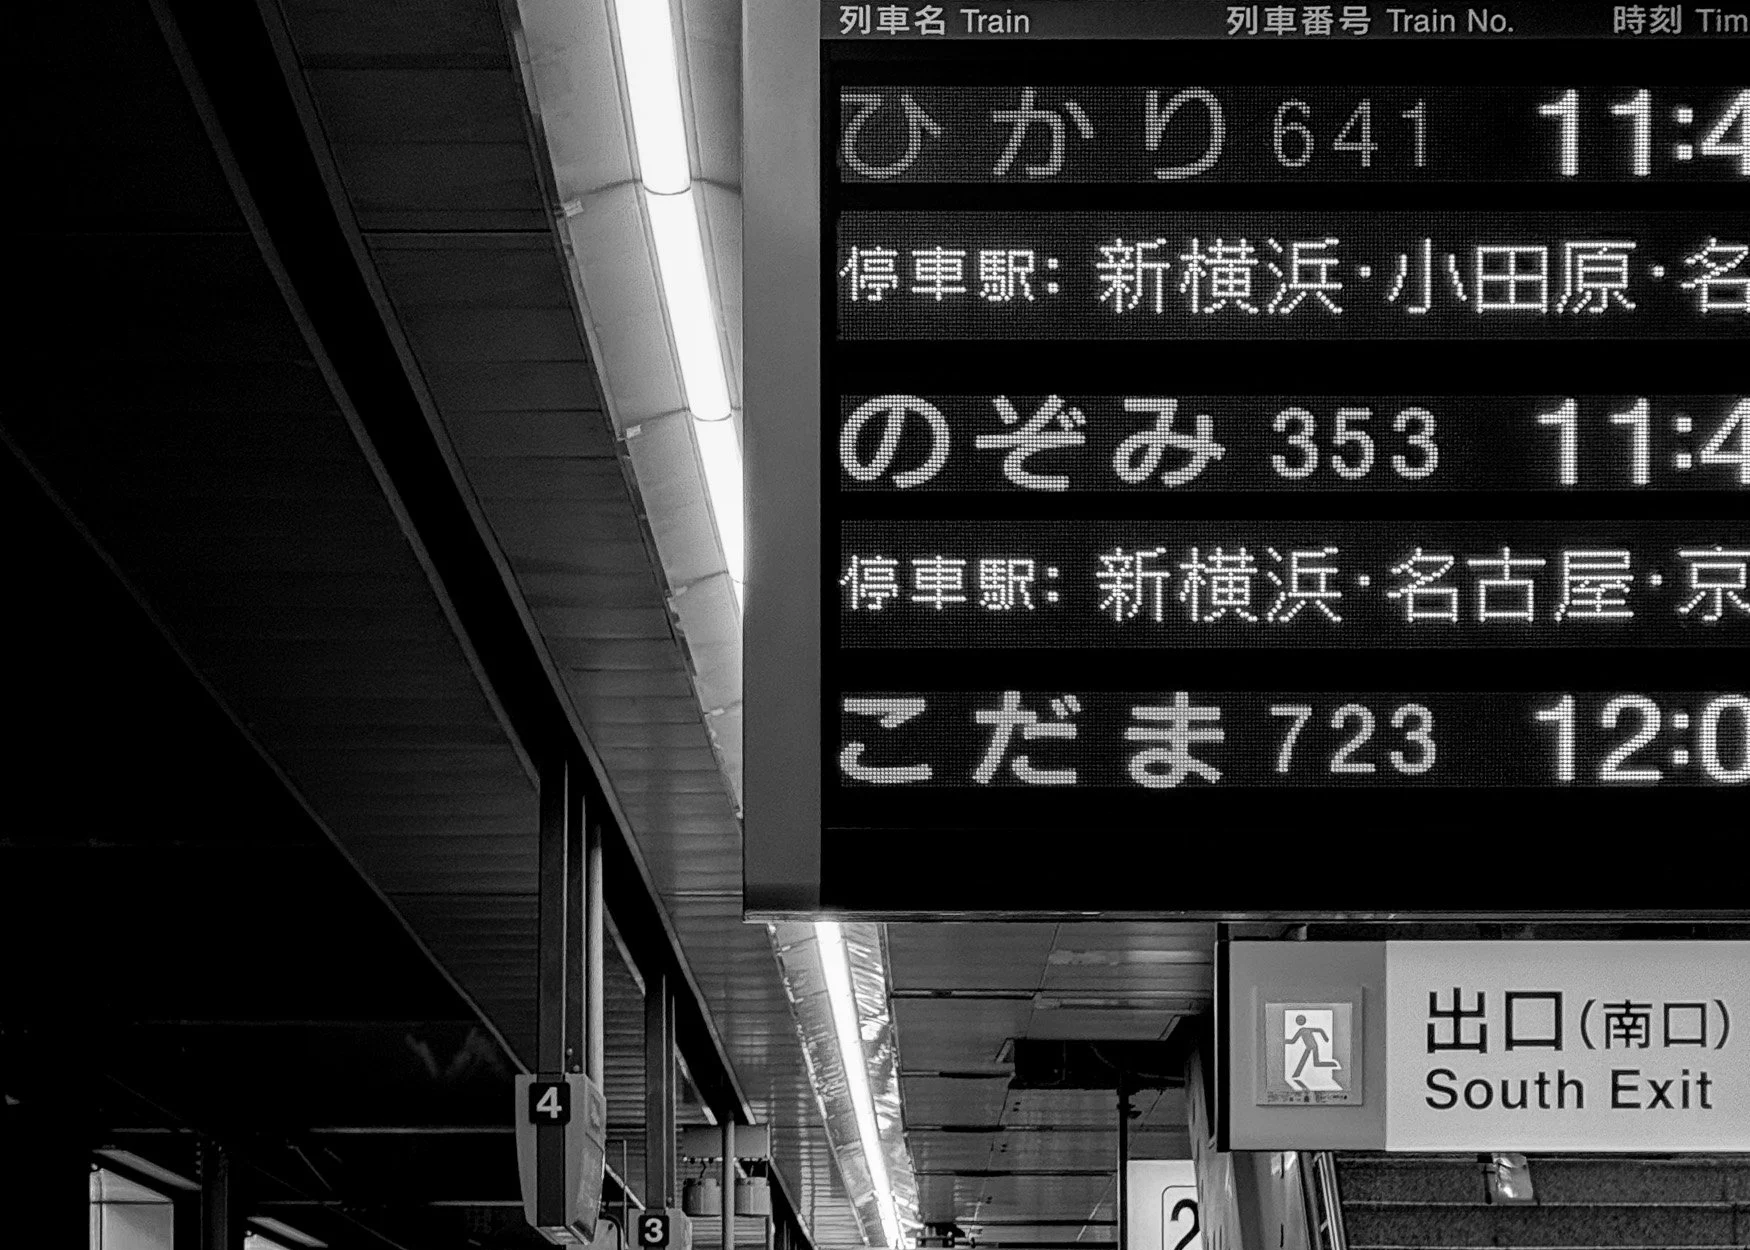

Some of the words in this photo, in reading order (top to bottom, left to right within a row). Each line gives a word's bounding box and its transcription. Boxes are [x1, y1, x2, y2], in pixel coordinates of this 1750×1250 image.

[839, 5, 945, 36] 列車名
[959, 9, 1030, 33] Train
[1226, 5, 1371, 36] 列車番号
[1386, 9, 1455, 33] Train
[1468, 9, 1515, 33] No.
[1613, 5, 1682, 36] 時刻
[1273, 98, 1427, 167] 641
[1272, 406, 1439, 479] 353
[1270, 703, 1437, 776] 723
[536, 1087, 562, 1118] 4
[1425, 1068, 1585, 1110] South
[1611, 1068, 1713, 1110] Exit
[644, 1218, 663, 1243] 3
